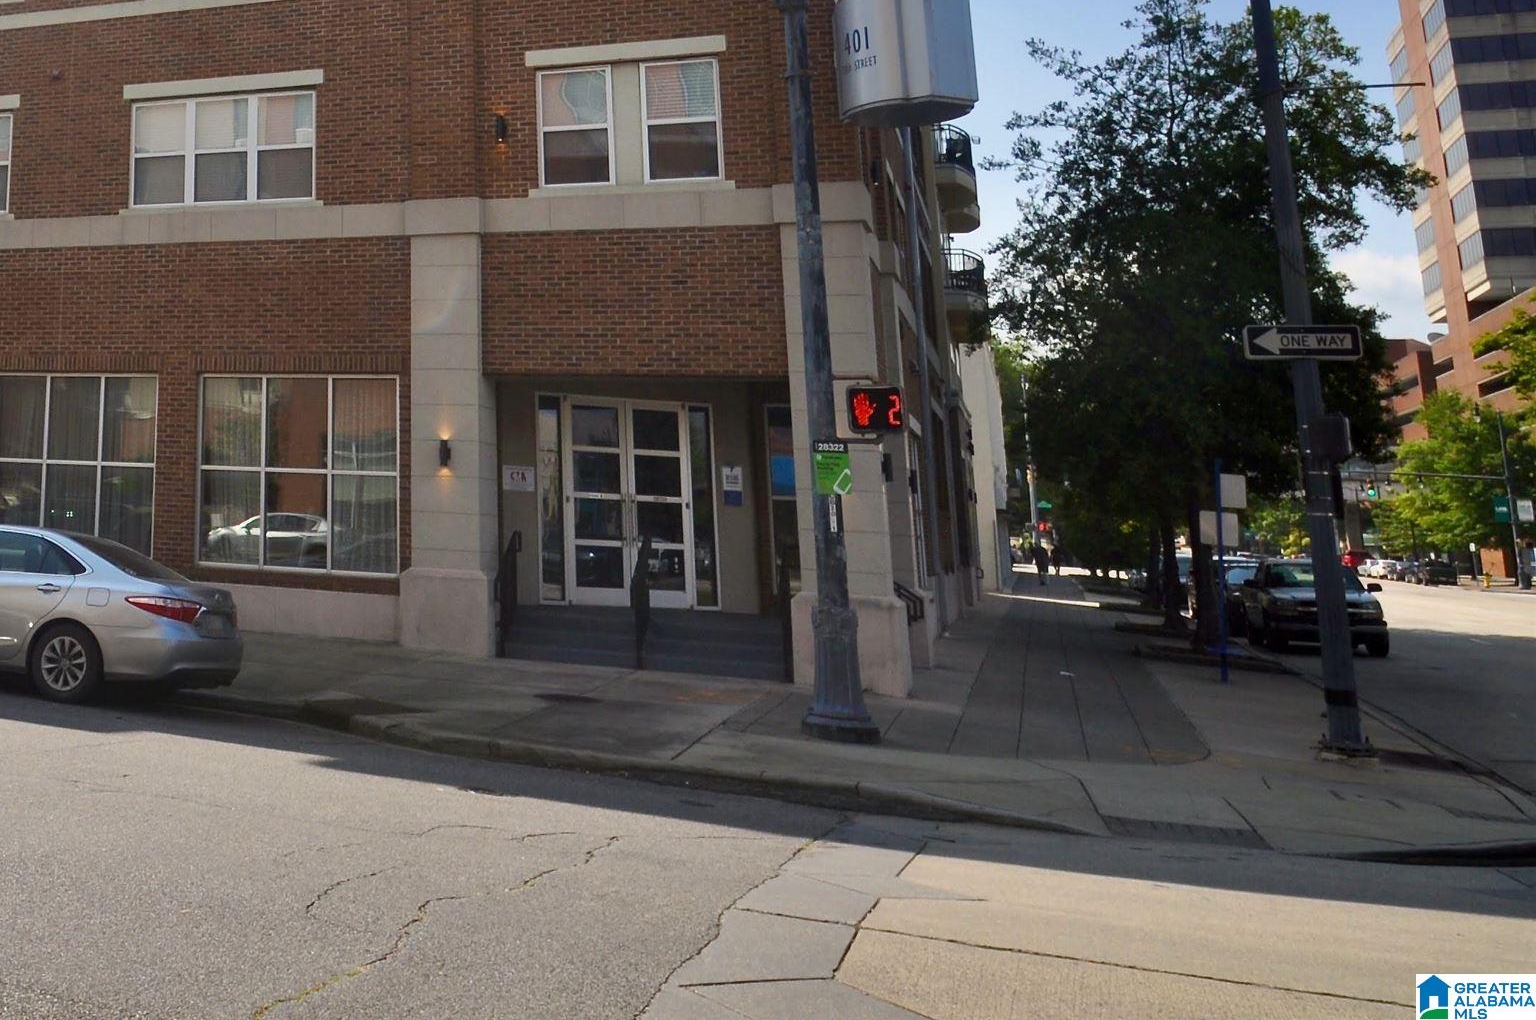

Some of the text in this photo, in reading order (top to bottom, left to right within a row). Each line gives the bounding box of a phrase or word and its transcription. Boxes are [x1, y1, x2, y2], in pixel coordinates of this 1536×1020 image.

[843, 26, 869, 55] 401
[854, 55, 877, 70] STREET
[1280, 335, 1347, 348] ONE WAY
[888, 395, 901, 425] 2
